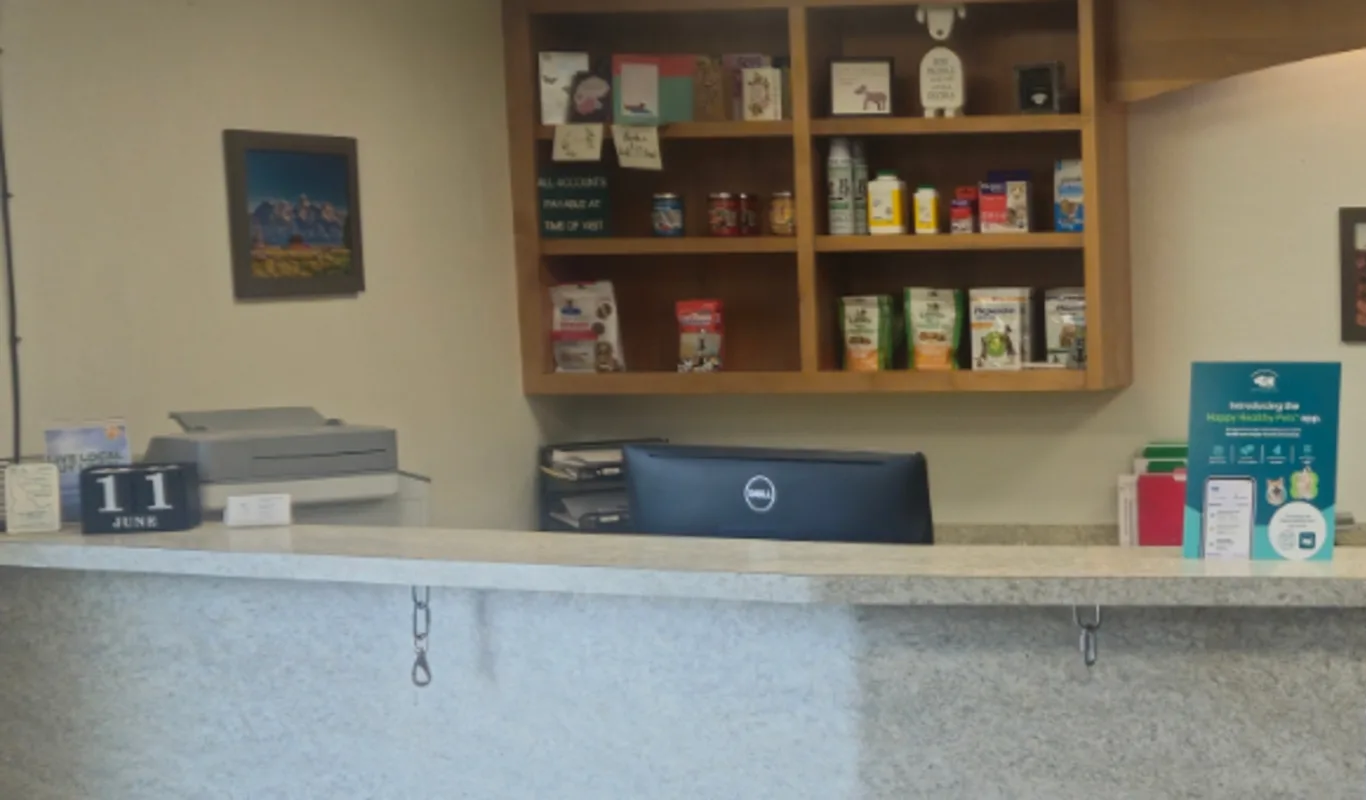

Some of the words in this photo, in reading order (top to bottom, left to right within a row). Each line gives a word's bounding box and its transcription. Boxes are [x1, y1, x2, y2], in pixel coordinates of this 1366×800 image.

[1284, 402, 1300, 411] the
[748, 489, 771, 499] DELL
[112, 516, 157, 528] JUNE
